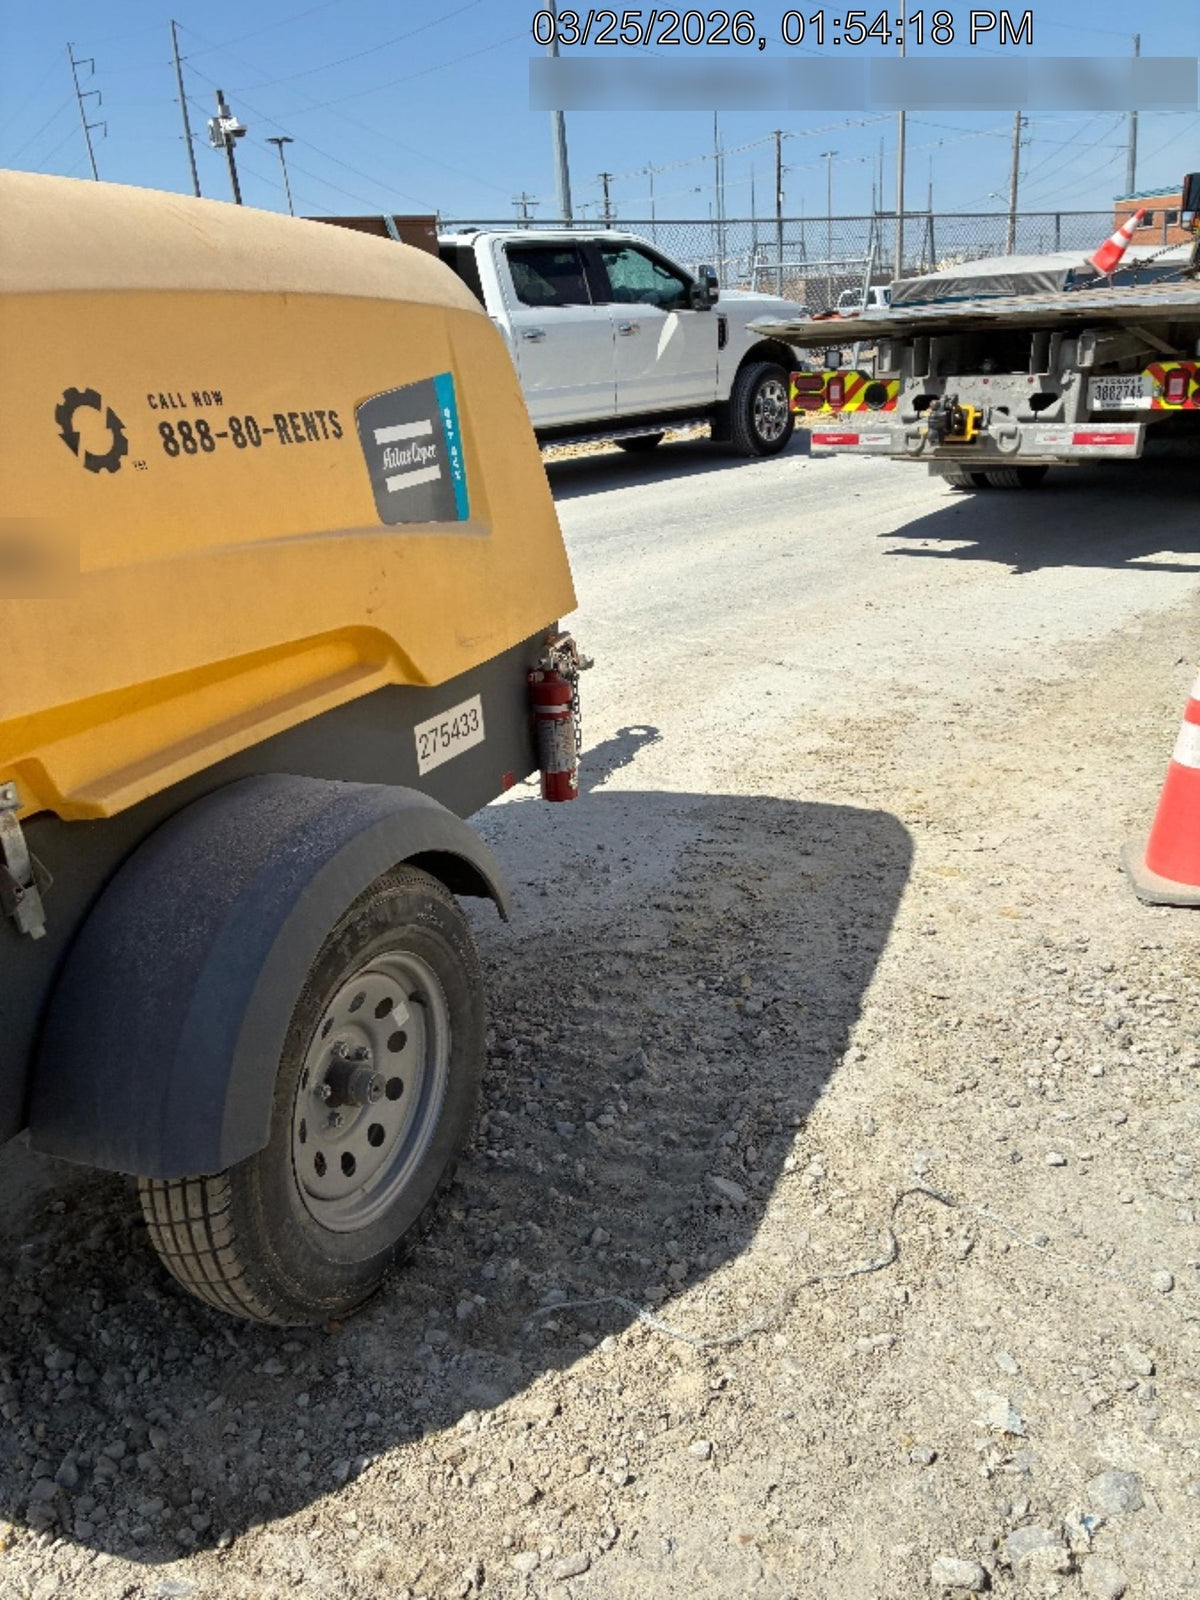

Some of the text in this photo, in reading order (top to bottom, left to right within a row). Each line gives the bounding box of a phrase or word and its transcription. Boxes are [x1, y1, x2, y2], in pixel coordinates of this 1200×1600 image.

[147, 389, 224, 410] CALL NOW
[158, 409, 344, 458] 888-80-RENTS
[418, 708, 480, 761] 275433
